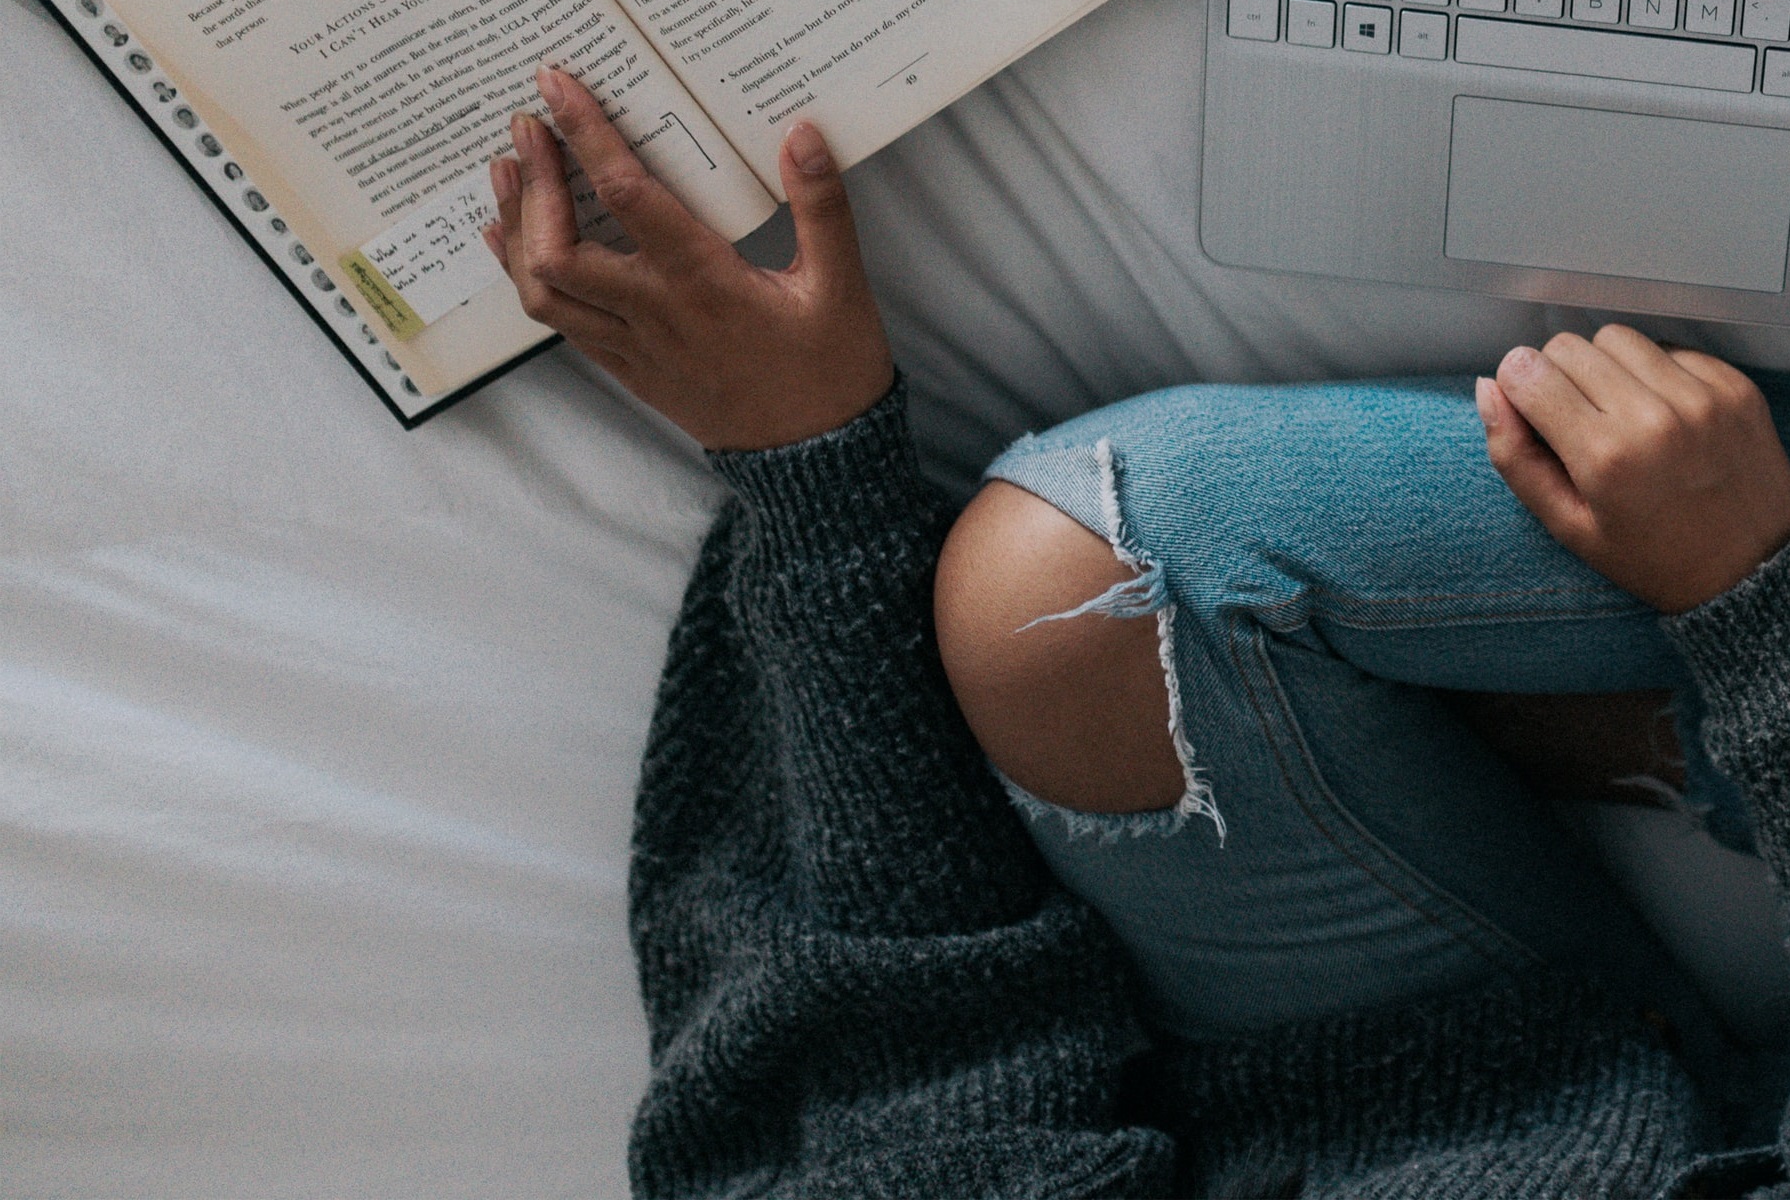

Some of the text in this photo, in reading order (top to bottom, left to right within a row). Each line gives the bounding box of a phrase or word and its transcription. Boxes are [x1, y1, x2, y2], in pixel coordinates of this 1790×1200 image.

[1246, 13, 1262, 21] ctrl
[1417, 32, 1429, 40] alt
[905, 73, 918, 86] 49
[368, 241, 399, 264] What
